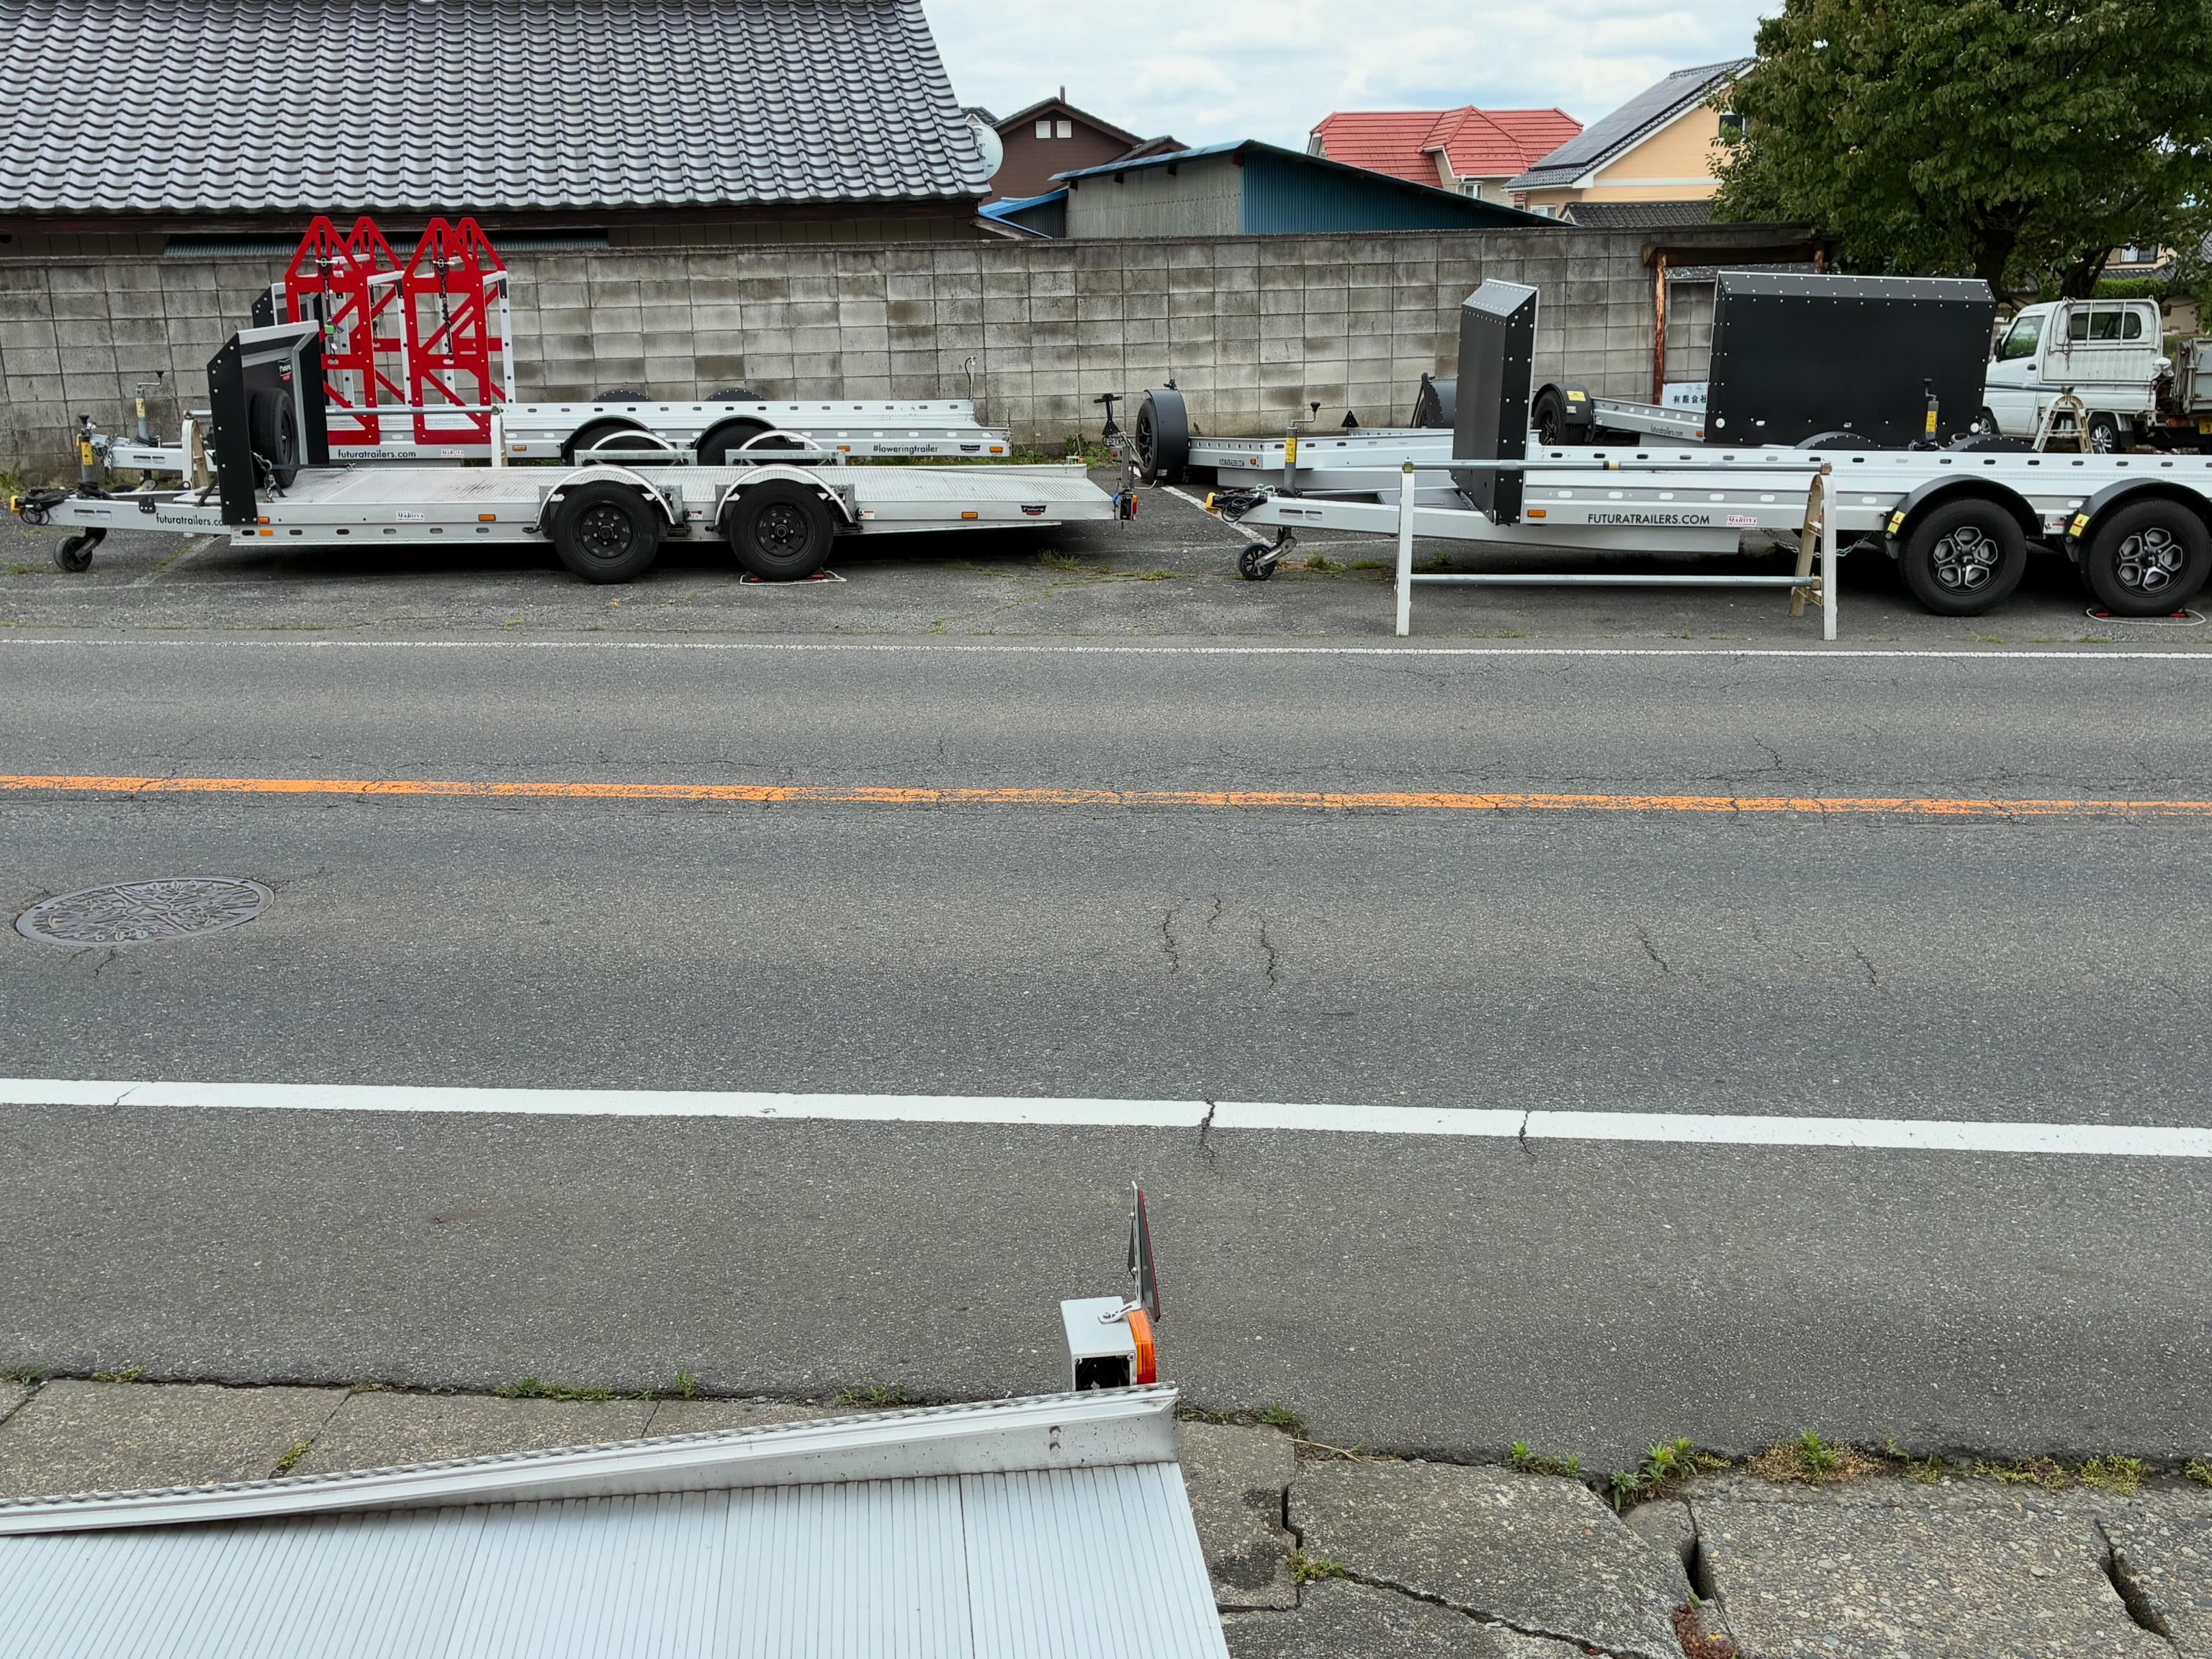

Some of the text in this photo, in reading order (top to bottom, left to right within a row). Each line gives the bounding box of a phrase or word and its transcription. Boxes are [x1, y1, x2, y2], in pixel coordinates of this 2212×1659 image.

[338, 449, 416, 459] futuratrailers.com
[873, 444, 939, 454] #loweringtrailer
[156, 513, 225, 526] futuratrailers.co
[1587, 513, 1710, 525] FUTURATRAILERS.COM
